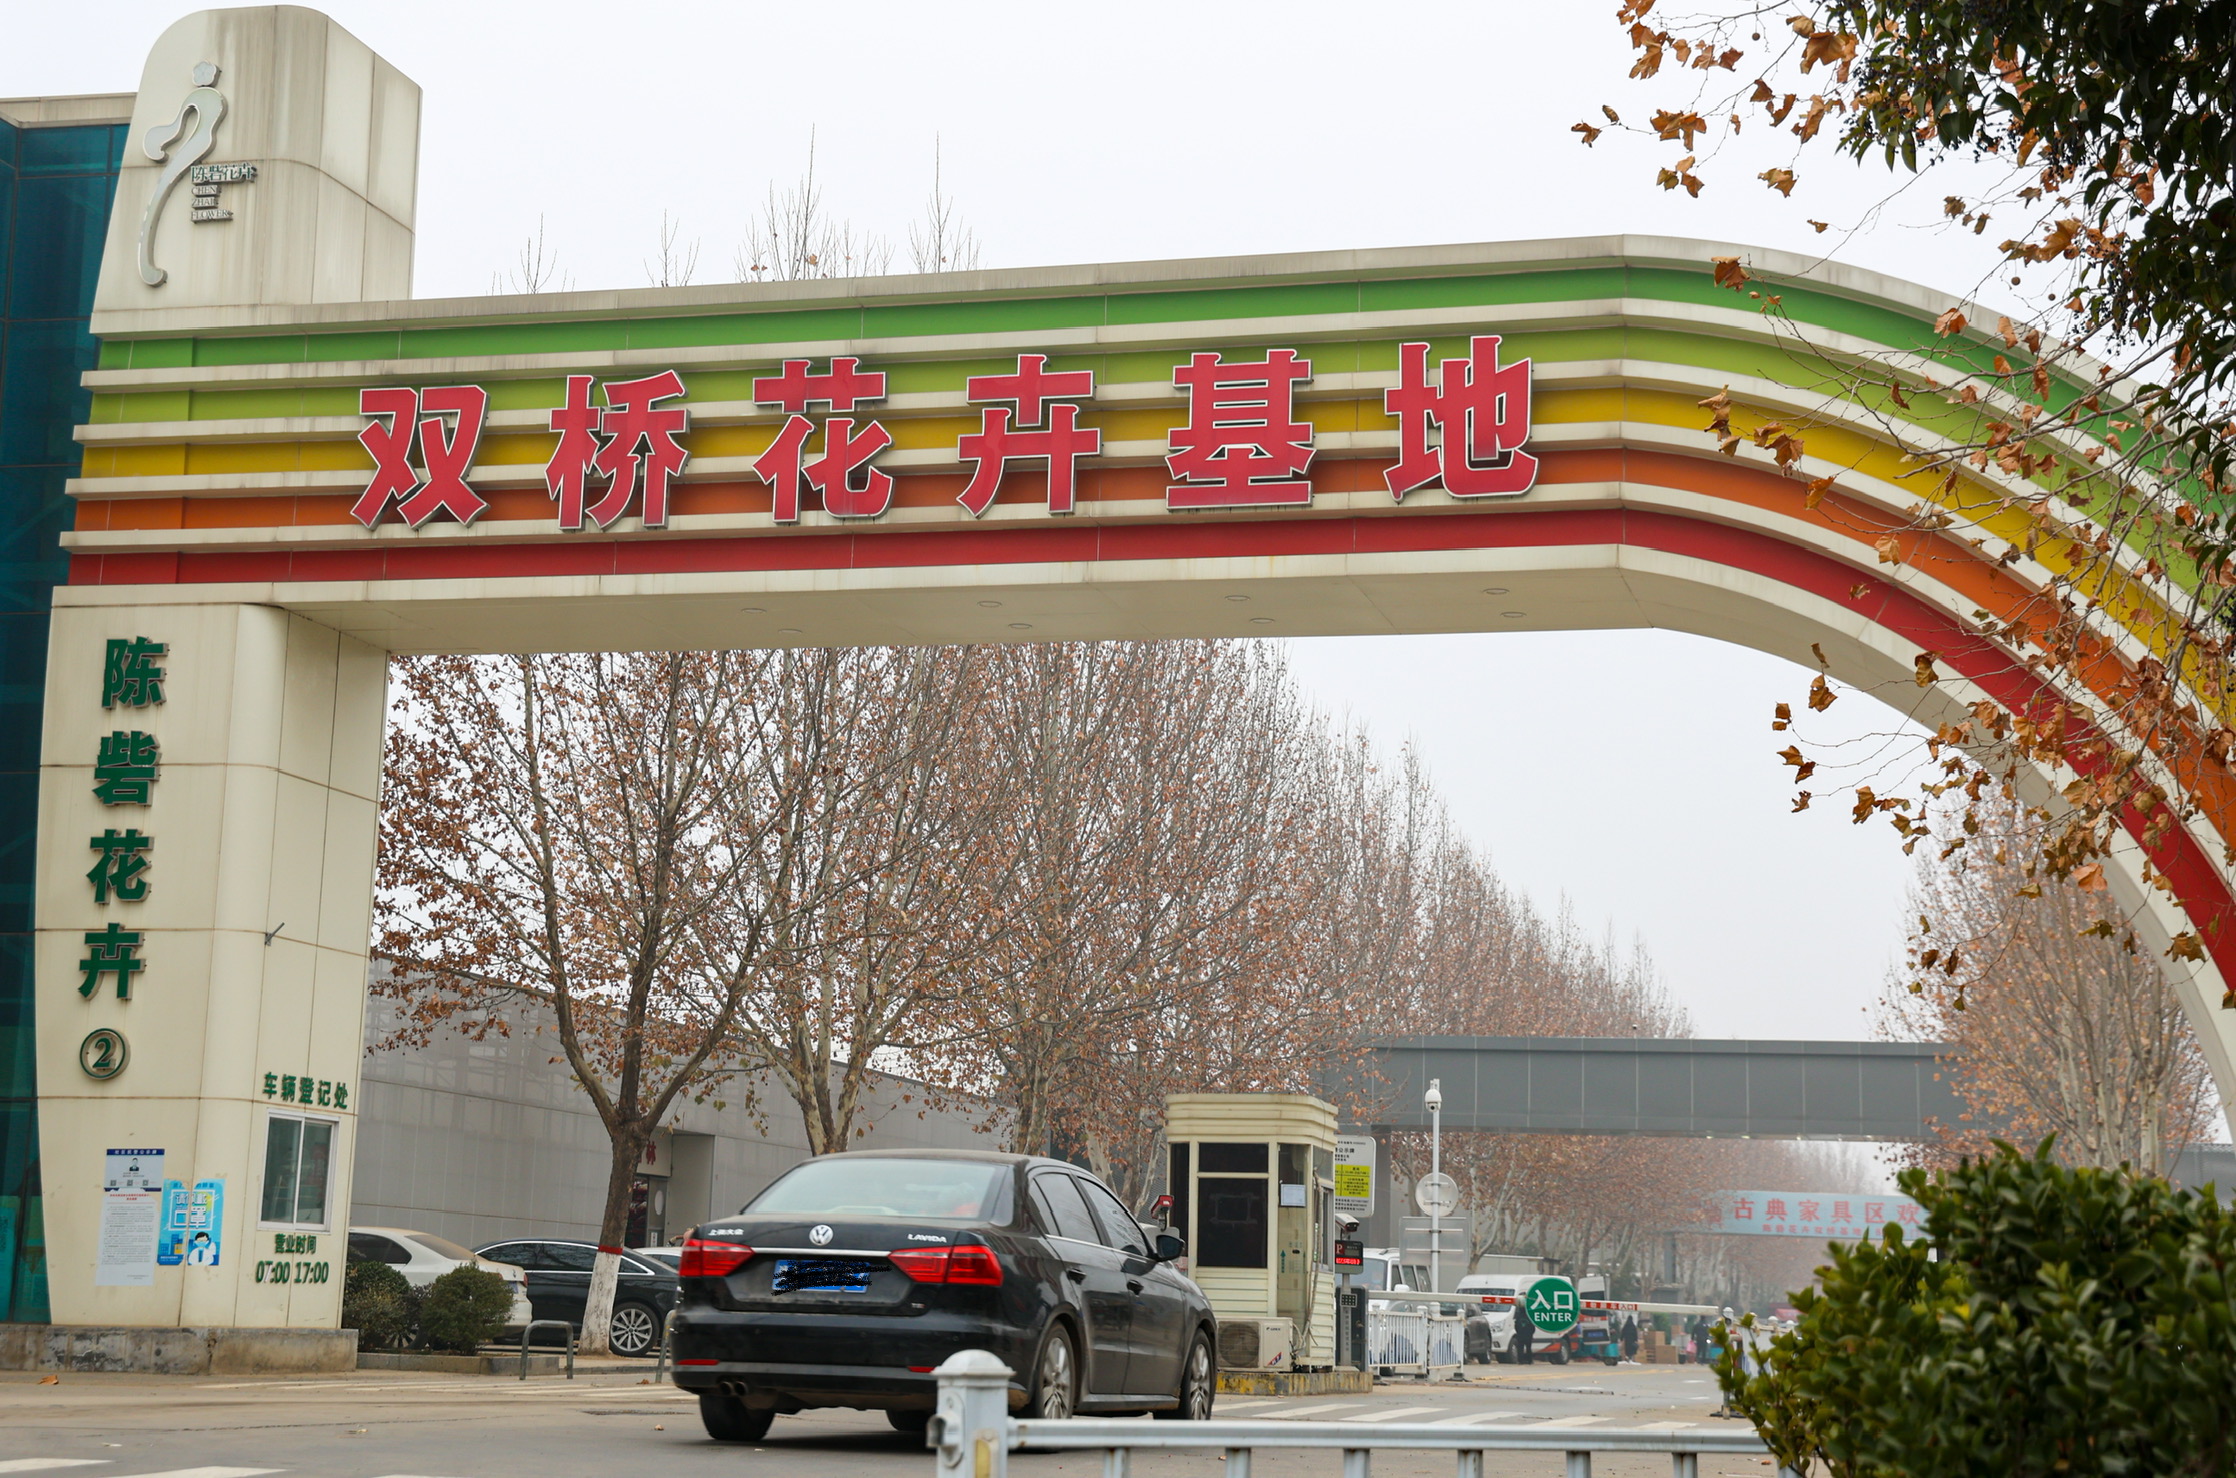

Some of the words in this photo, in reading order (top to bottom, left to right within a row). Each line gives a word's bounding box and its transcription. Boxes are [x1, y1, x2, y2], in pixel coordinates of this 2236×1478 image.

[191, 162, 254, 183] 陈砦花卉
[191, 185, 218, 196] CHEN
[191, 197, 216, 208] ZHAI
[350, 334, 1539, 531] 双桥花卉基地
[78, 636, 169, 1001] 陈砦花卉
[262, 1071, 348, 1110] 车辆登记处
[275, 1233, 317, 1254] 营业时间
[907, 1233, 948, 1244] LAVIDA
[256, 1260, 291, 1284] 07:00
[294, 1261, 330, 1284] 17:00
[1530, 1289, 1573, 1310] 入口
[1533, 1312, 1573, 1322] ENTER
